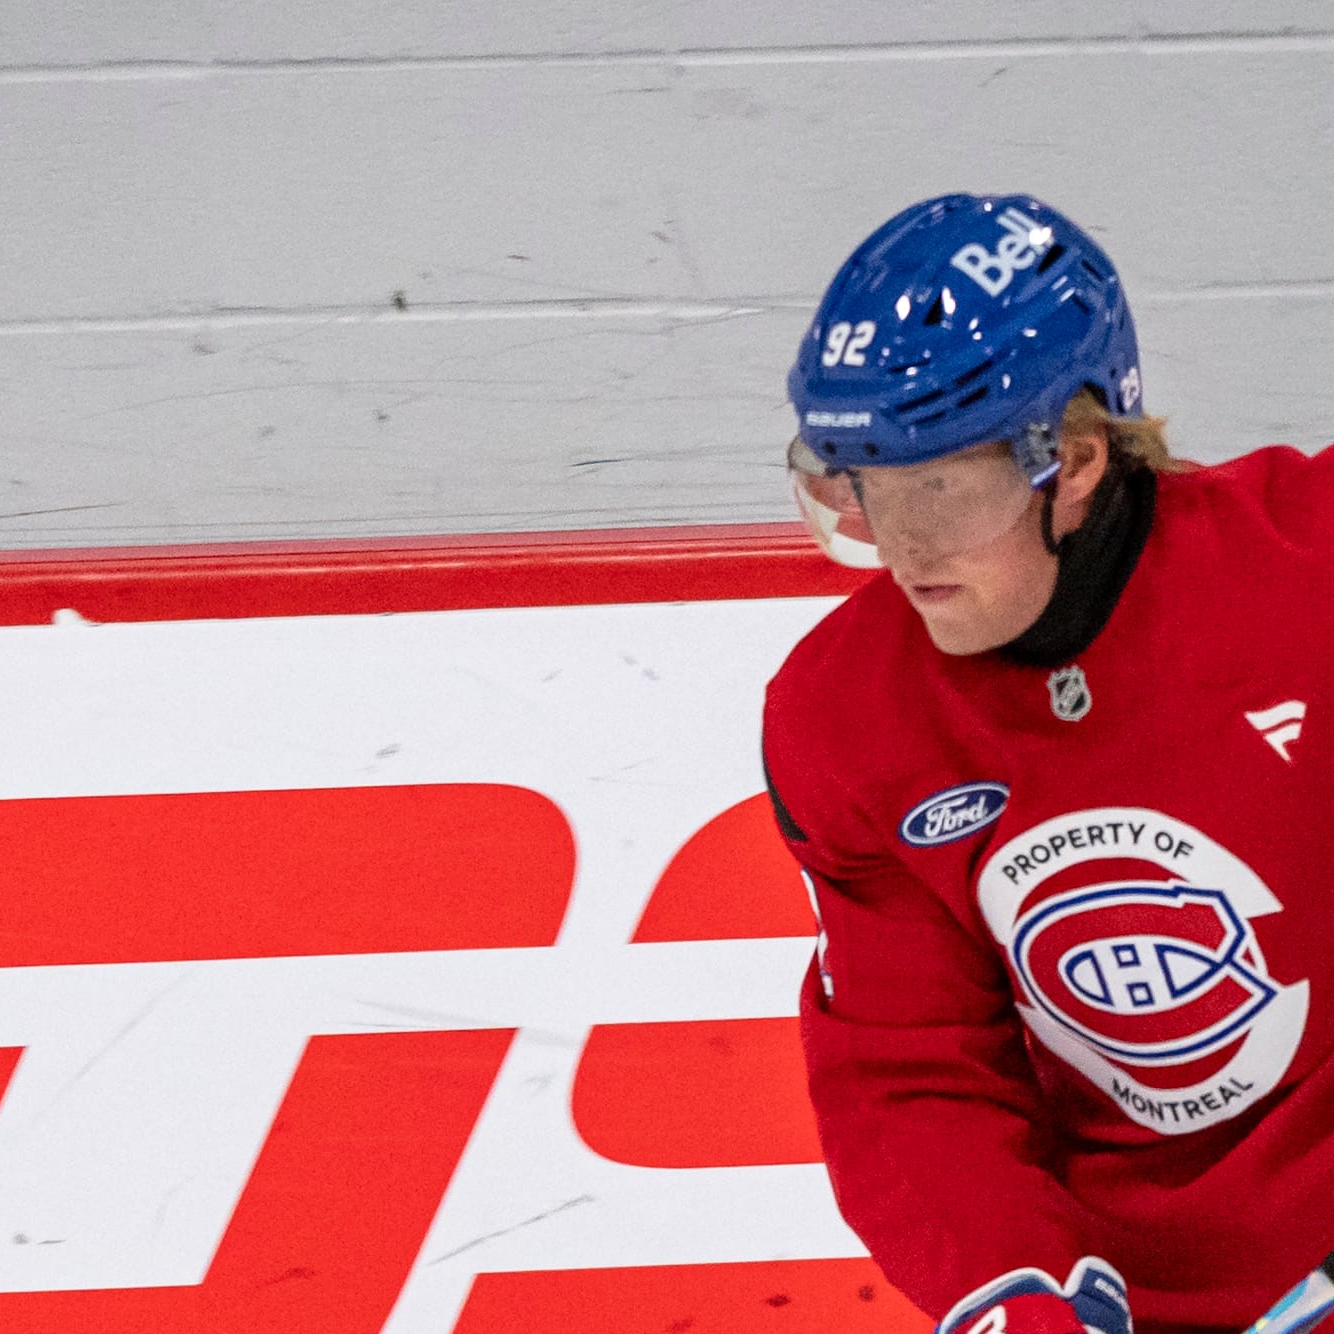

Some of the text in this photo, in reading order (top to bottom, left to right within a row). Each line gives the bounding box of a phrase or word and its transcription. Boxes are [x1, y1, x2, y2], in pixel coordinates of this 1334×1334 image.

[950, 206, 1056, 297] Bell
[822, 320, 876, 367] 92
[924, 794, 988, 838] Ford
[1002, 821, 1194, 886] PROPERTY OF
[1111, 1076, 1254, 1122] MONTREAL
